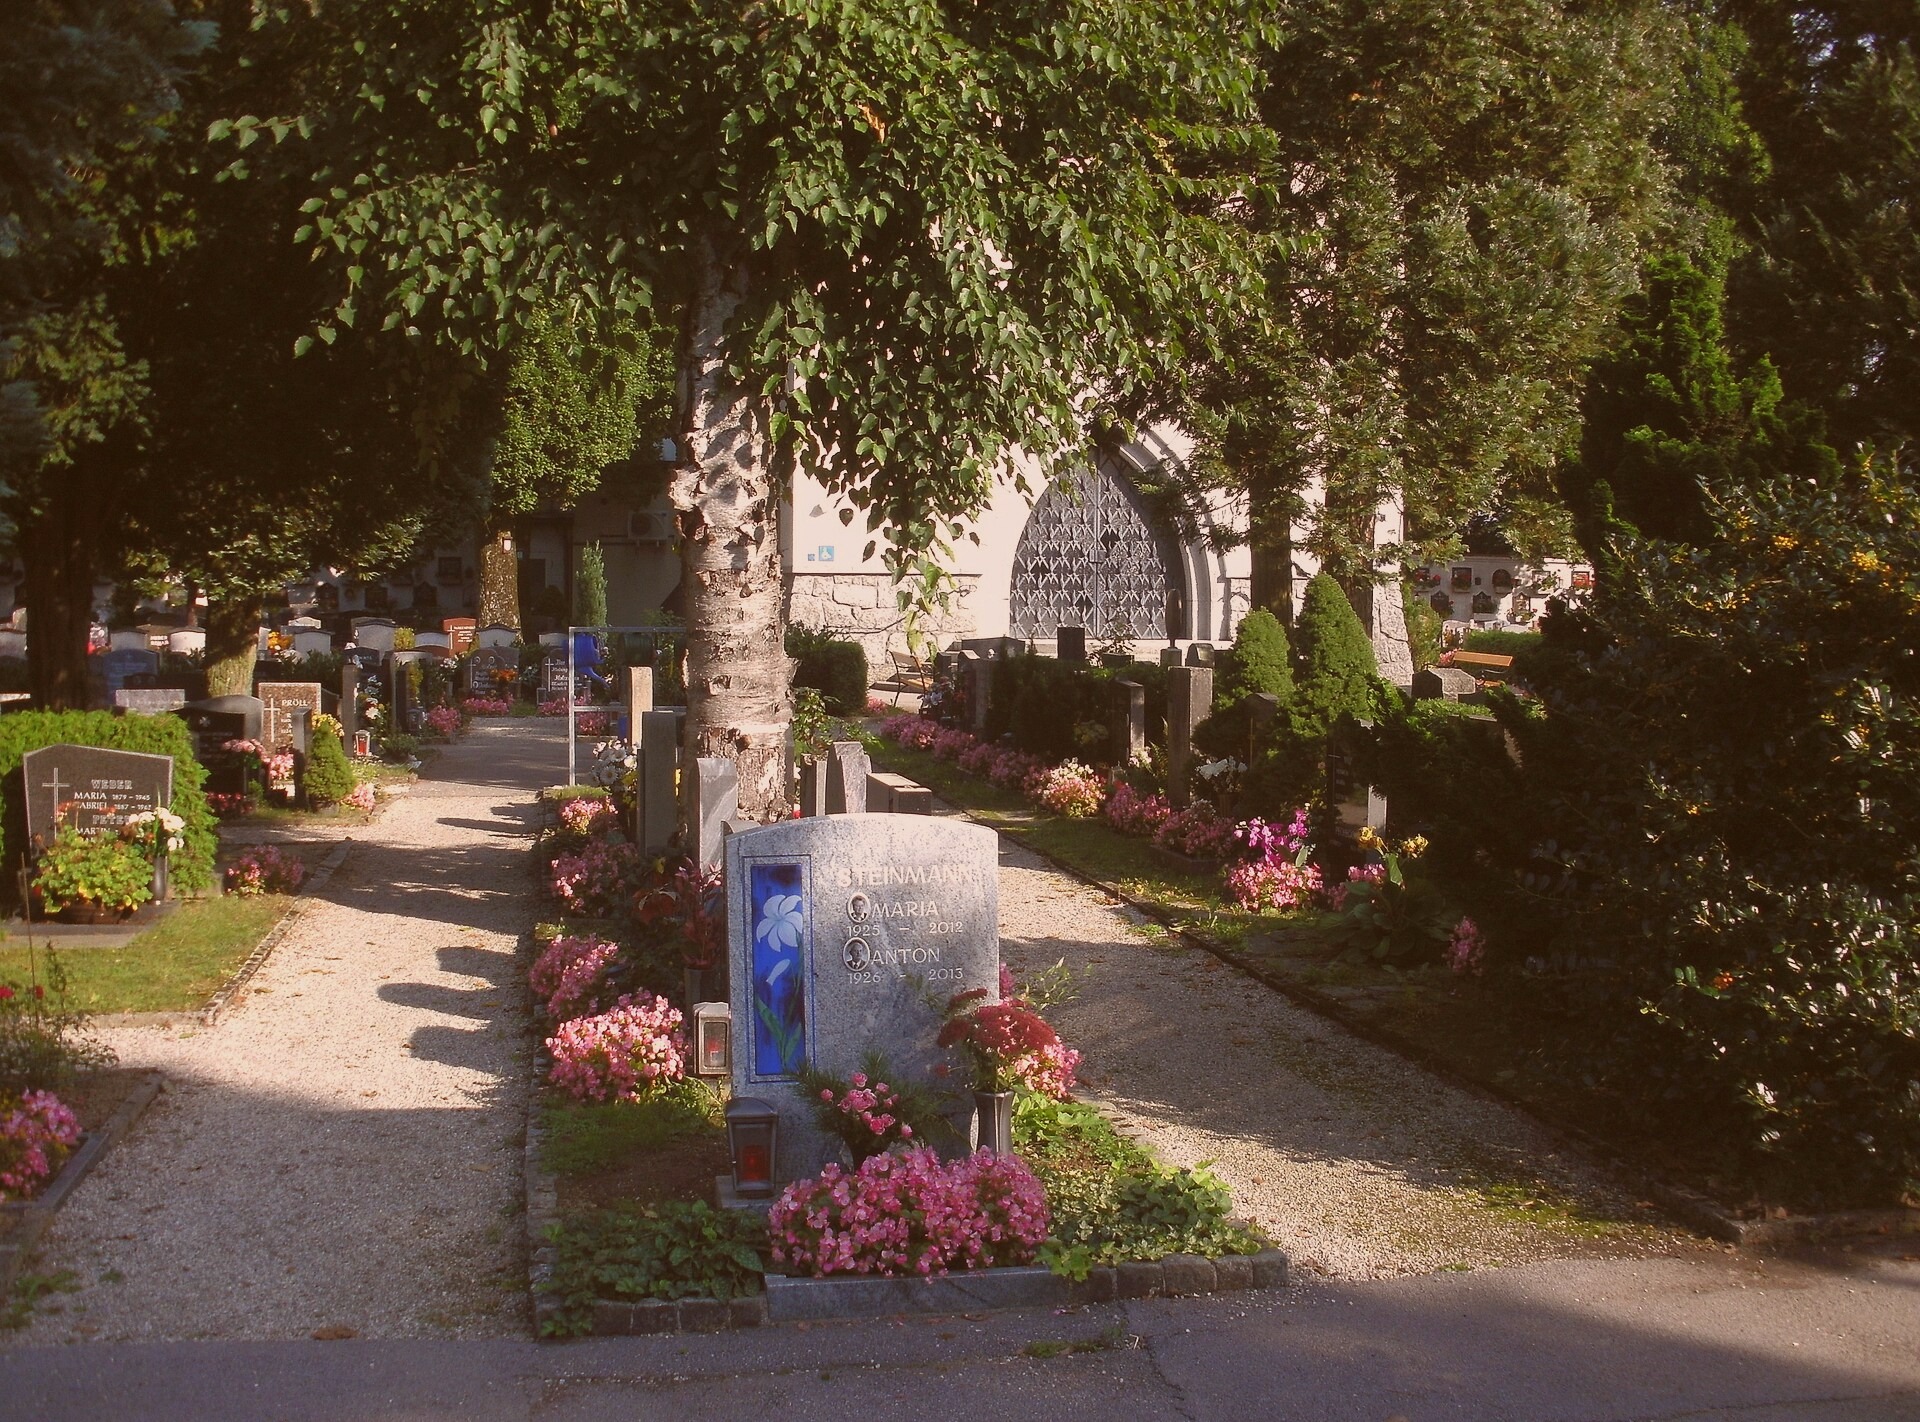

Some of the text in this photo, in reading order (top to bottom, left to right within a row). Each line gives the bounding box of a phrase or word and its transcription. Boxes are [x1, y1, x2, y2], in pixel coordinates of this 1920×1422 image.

[282, 698, 307, 707] PRÖLL
[91, 779, 133, 790] WEBER
[74, 792, 107, 800] MARIA
[77, 801, 107, 809] ABRIEL
[837, 864, 973, 888] STEINMANN
[872, 900, 939, 918] MARIA
[847, 924, 881, 938] 1925
[929, 921, 963, 934] 2012
[871, 947, 940, 965] ANTON
[847, 971, 882, 984] 1926
[928, 967, 964, 981] 2013
